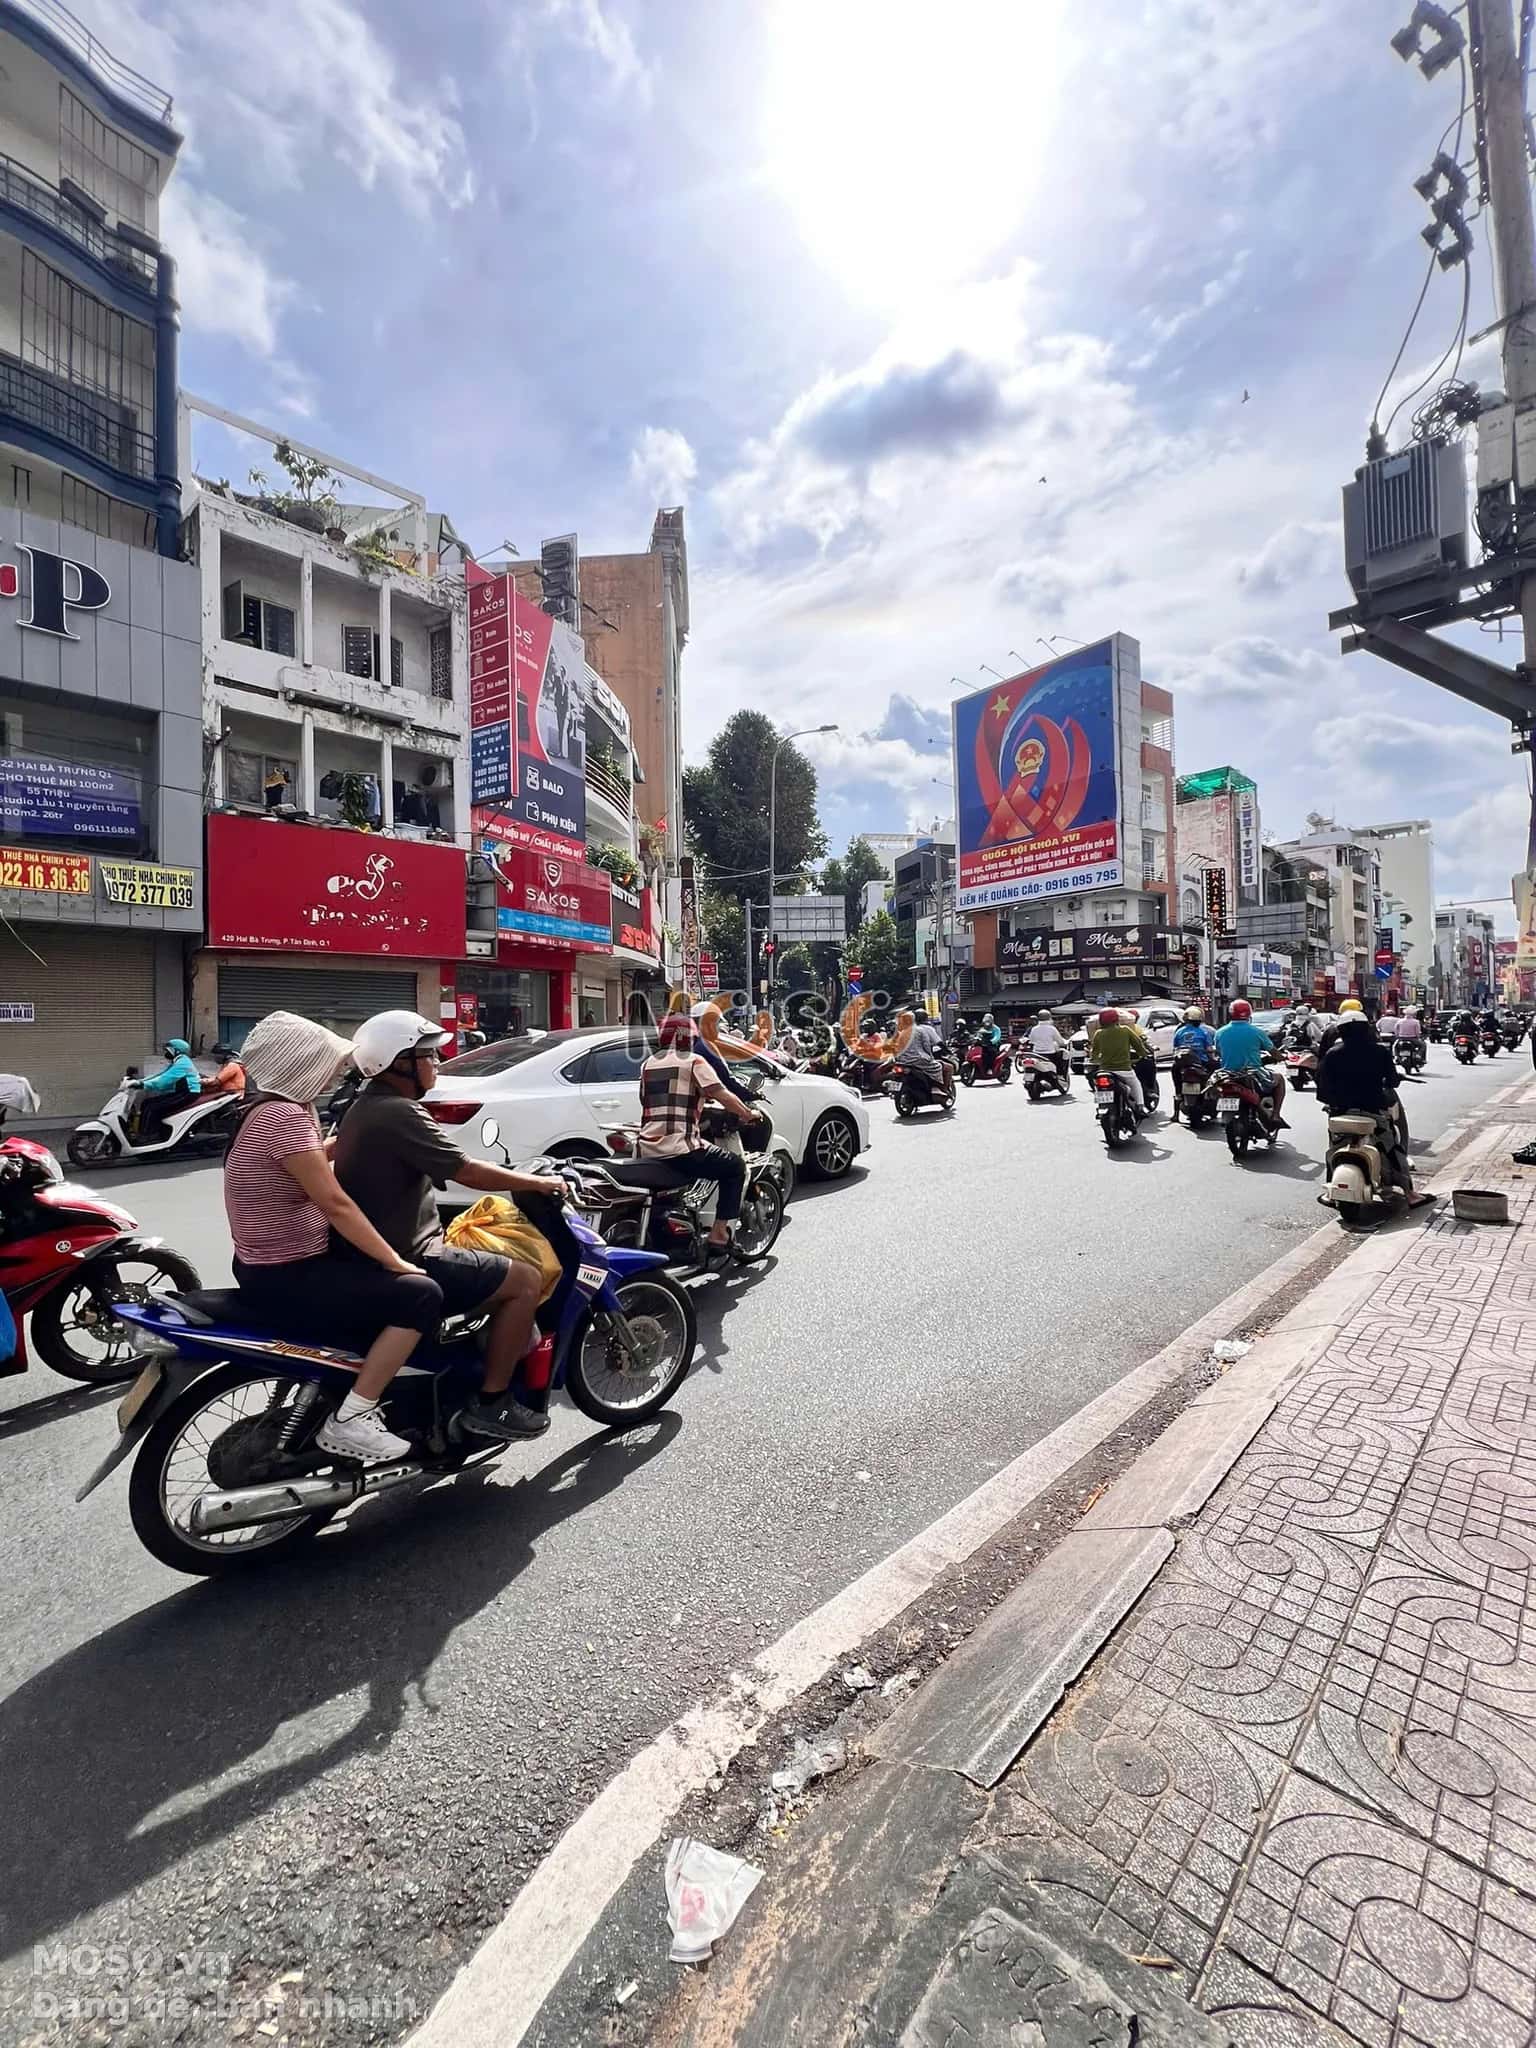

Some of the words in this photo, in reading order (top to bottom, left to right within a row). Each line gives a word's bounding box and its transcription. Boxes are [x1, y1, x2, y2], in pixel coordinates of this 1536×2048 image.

[15, 542, 111, 640] P
[473, 598, 505, 618] SAKOS
[17, 761, 37, 771] HAI
[40, 762, 55, 772] BÀ
[58, 765, 97, 777] TRƯNG
[27, 774, 56, 785] THUÊ
[542, 779, 564, 796] BALO
[26, 786, 40, 795] 55
[43, 788, 70, 798] Triệu
[541, 811, 558, 829] PHỤ
[560, 816, 577, 833] KIỆN
[982, 848, 1008, 860] QUỐC
[1010, 844, 1027, 855] HỘI
[1029, 838, 1059, 851] KHÓA
[1062, 832, 1081, 843] XVI
[2, 850, 23, 860] THUÊ
[119, 866, 137, 881] THUÊ
[139, 868, 154, 884] NHÀ
[141, 884, 165, 904] 377
[169, 886, 193, 907] 039
[959, 895, 976, 906] LIÊN
[978, 892, 989, 904] HỆ
[991, 885, 1019, 901] QUẢNG
[1021, 882, 1043, 896] CÁO:
[1045, 877, 1070, 891] 0916
[1072, 873, 1093, 886] 095
[1096, 869, 1118, 882] 795
[526, 888, 580, 909] SAKOS
[1003, 941, 1030, 957] Milan
[1086, 932, 1122, 949] Milan
[1113, 944, 1143, 956] Bakery
